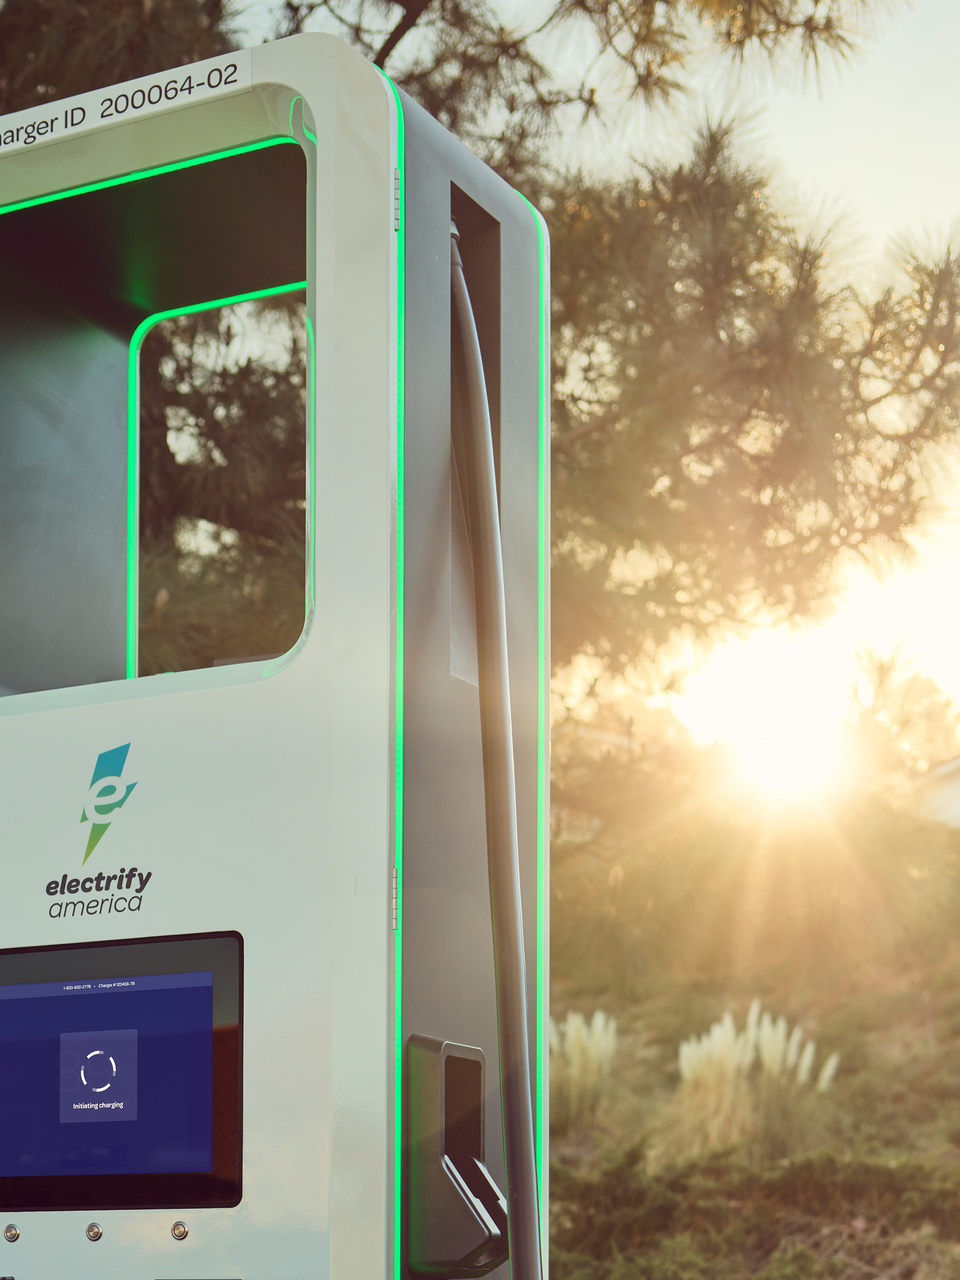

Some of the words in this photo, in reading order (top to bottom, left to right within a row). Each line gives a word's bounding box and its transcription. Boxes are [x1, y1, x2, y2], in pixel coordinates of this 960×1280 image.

[64, 106, 86, 129] ID
[100, 64, 238, 118] 200064-02
[45, 867, 152, 896] electrify
[48, 894, 143, 918] america
[73, 1102, 99, 1110] Initiating
[99, 1101, 124, 1109] charging
